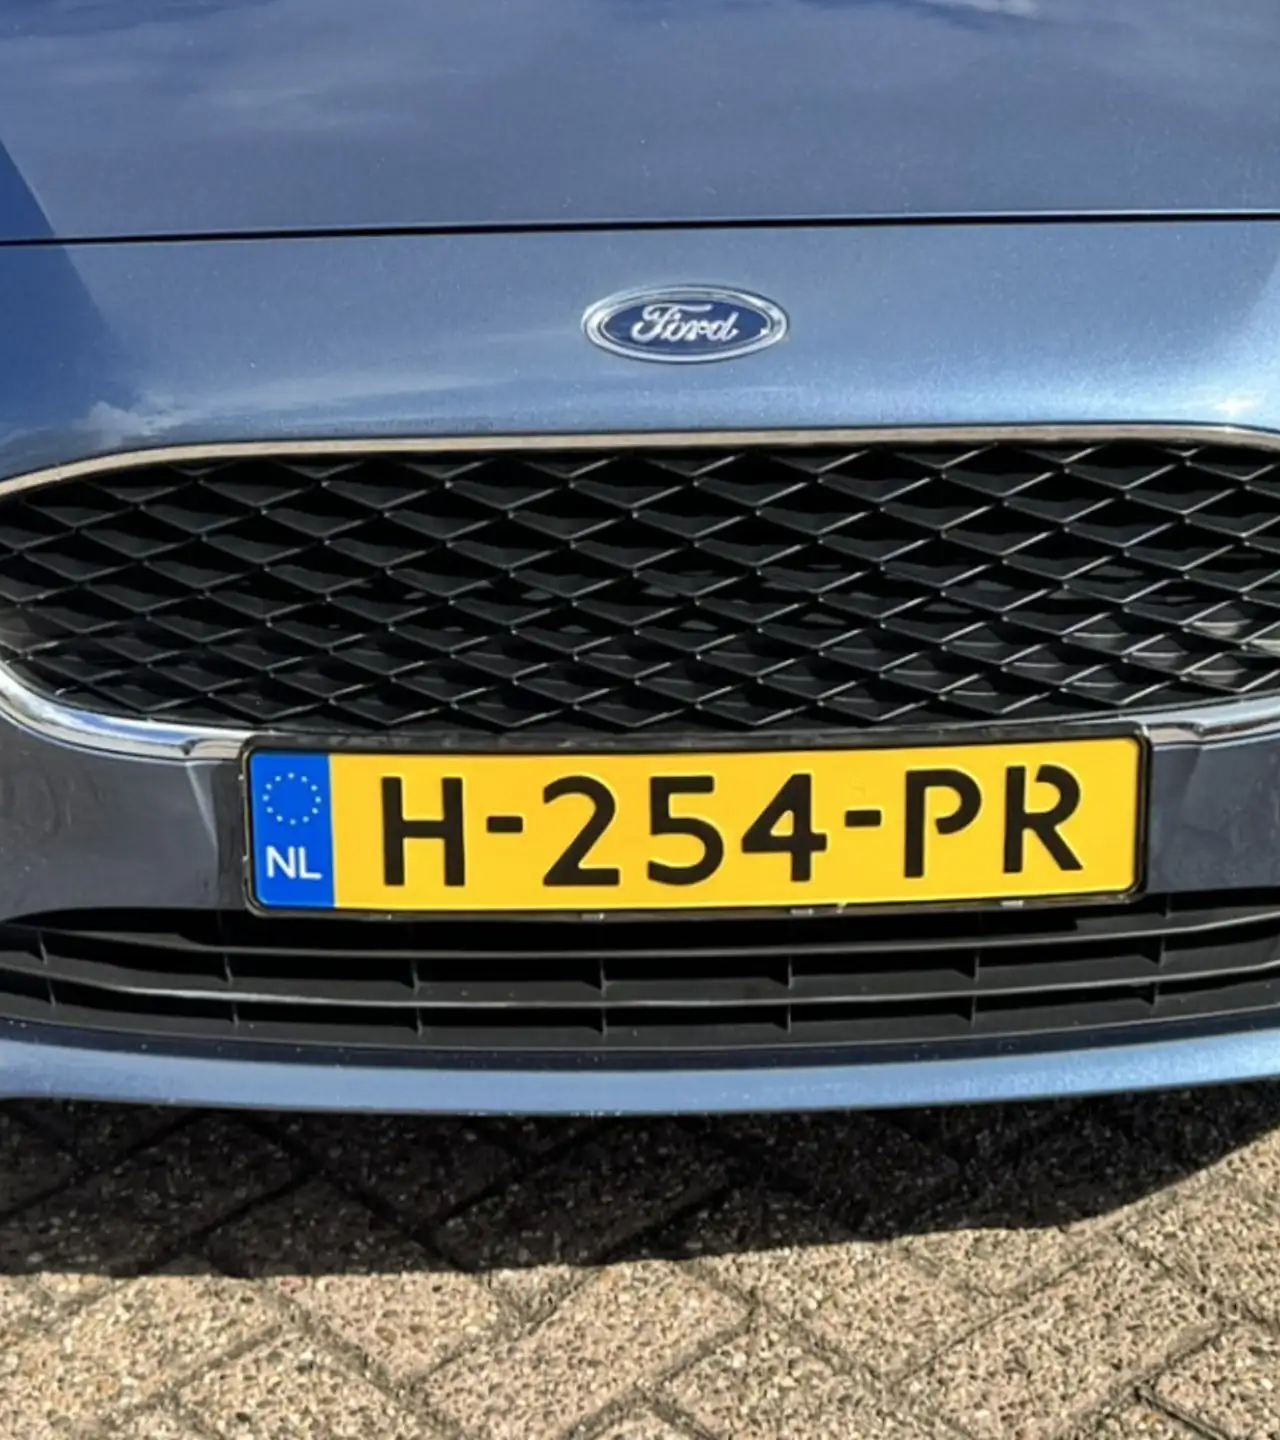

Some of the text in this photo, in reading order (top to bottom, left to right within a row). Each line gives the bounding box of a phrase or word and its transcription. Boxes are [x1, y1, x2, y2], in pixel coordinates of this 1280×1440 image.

[631, 303, 740, 343] Ford
[380, 764, 1084, 889] H-254-PR
[265, 844, 323, 882] NL
